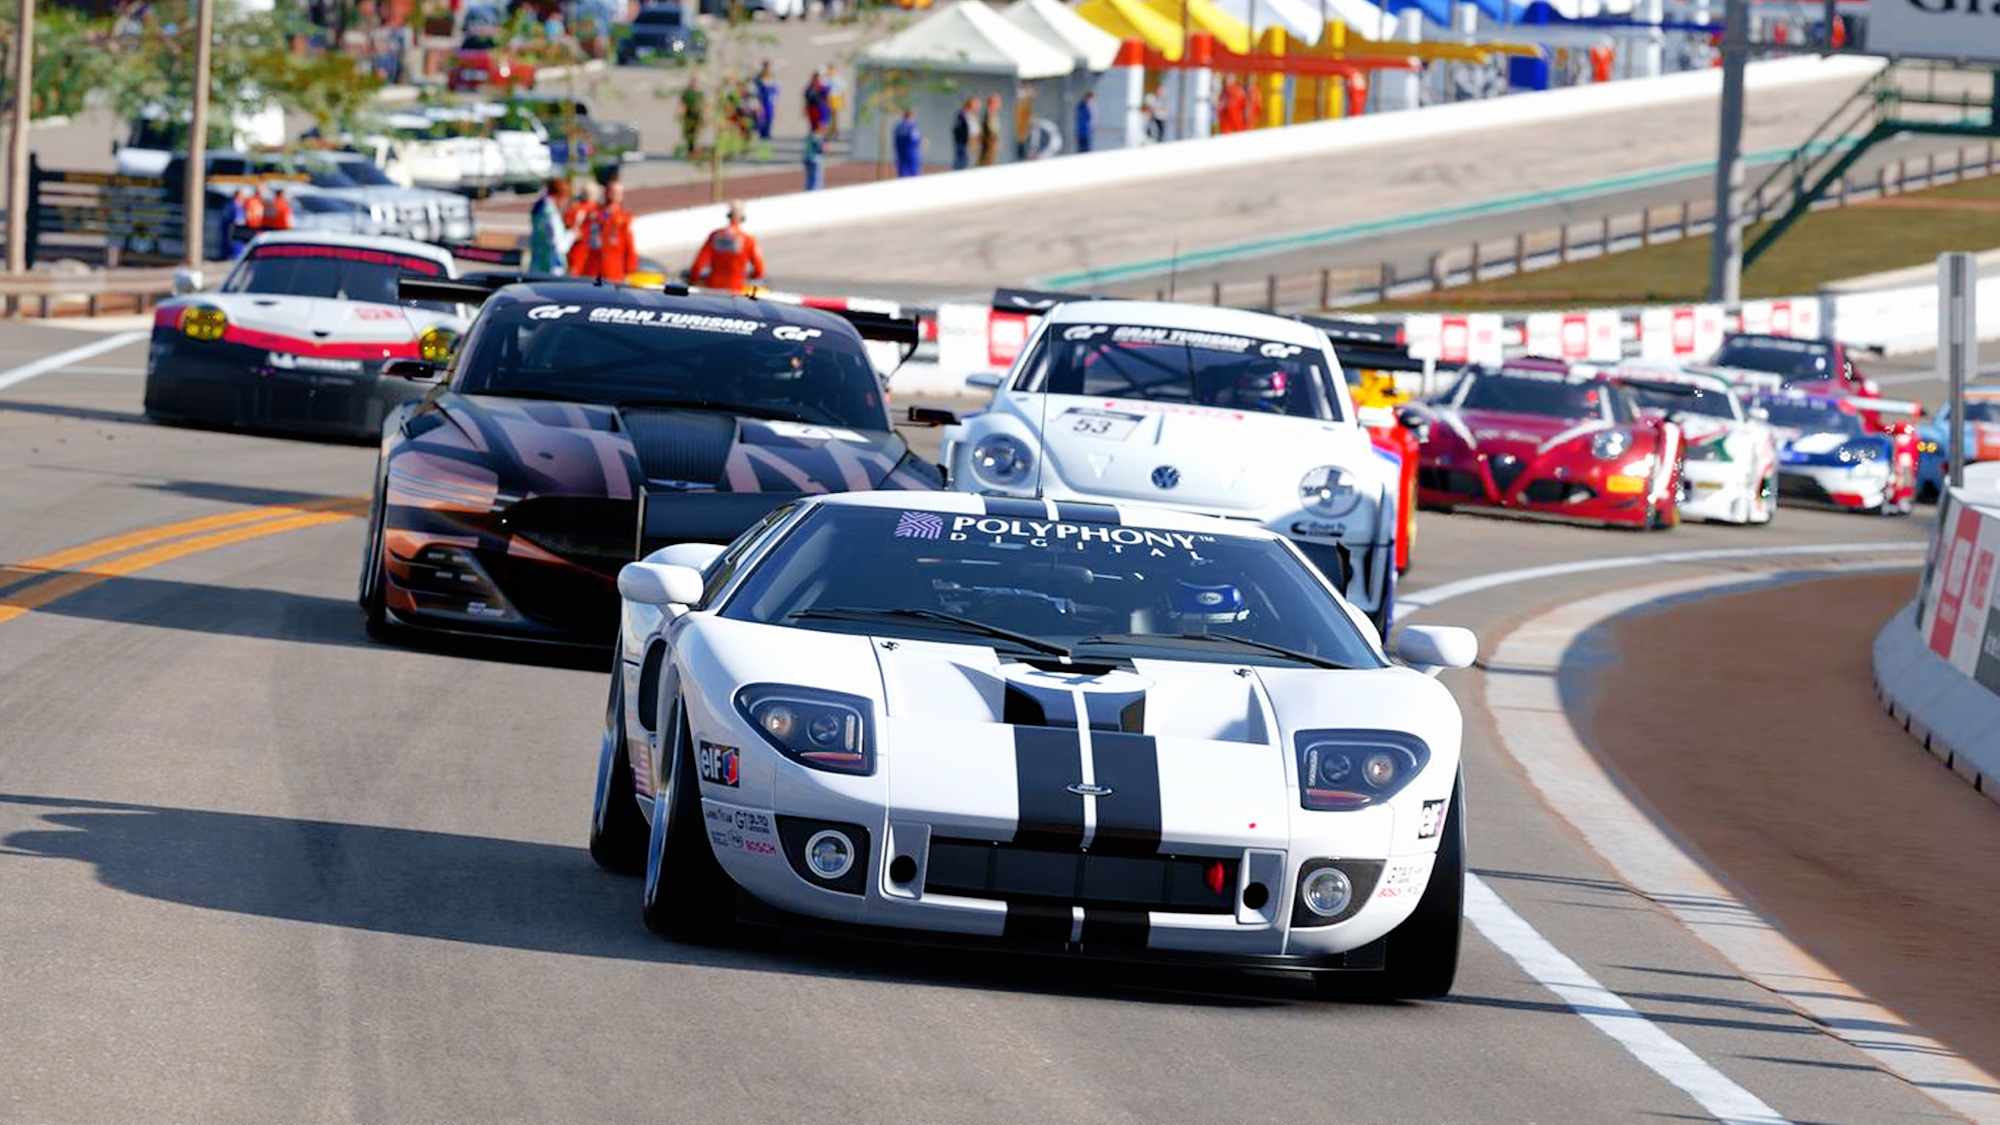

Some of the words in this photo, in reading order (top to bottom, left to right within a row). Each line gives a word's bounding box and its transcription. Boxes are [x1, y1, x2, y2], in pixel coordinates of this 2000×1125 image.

[589, 307, 655, 323] GRAN
[660, 312, 758, 332] TURISMO
[1112, 326, 1168, 341] GRAN
[1169, 329, 1251, 349] TURISMO
[1072, 417, 1113, 435] 53
[700, 747, 722, 781] elf
